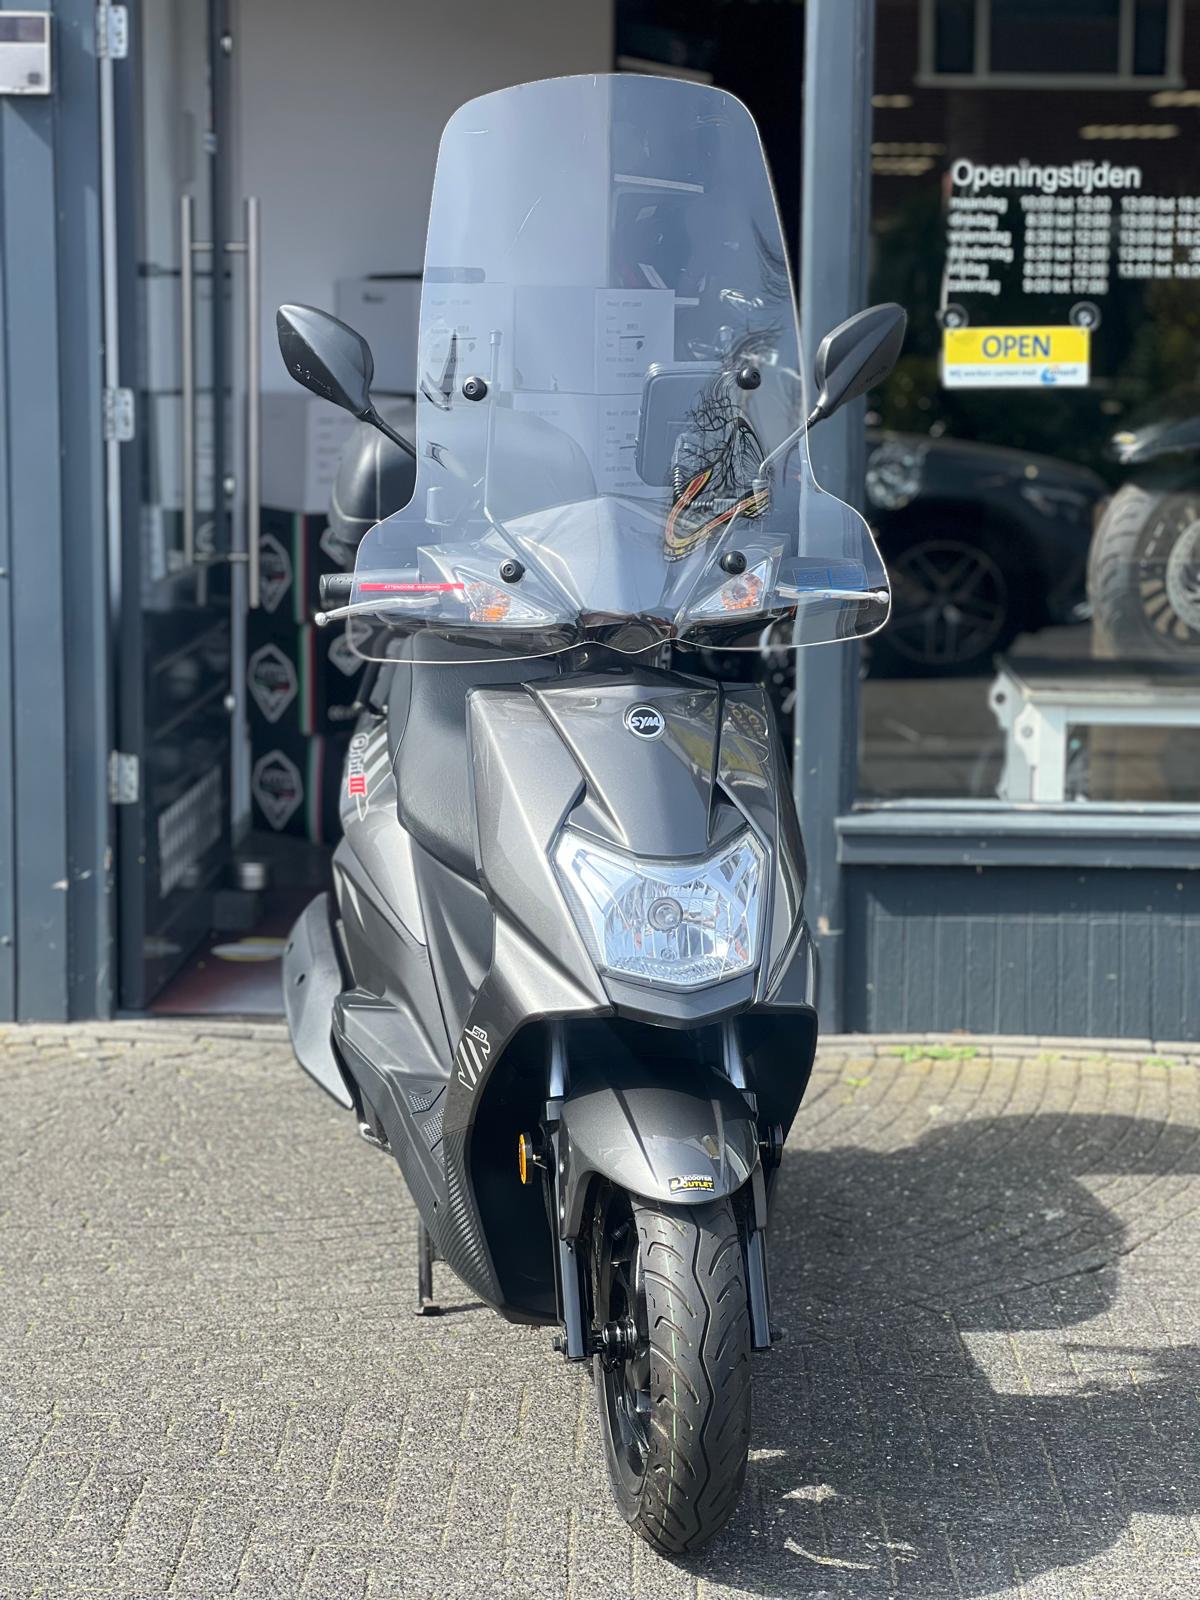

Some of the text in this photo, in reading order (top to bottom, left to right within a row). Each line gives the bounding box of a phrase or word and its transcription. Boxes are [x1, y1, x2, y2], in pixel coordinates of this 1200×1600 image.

[952, 159, 1141, 193] Openingstijden
[950, 195, 1008, 214] maandag
[982, 335, 1050, 358] OPEN
[630, 716, 660, 729] SYM
[472, 1027, 487, 1041] 50
[682, 1180, 714, 1188] OUTLET
